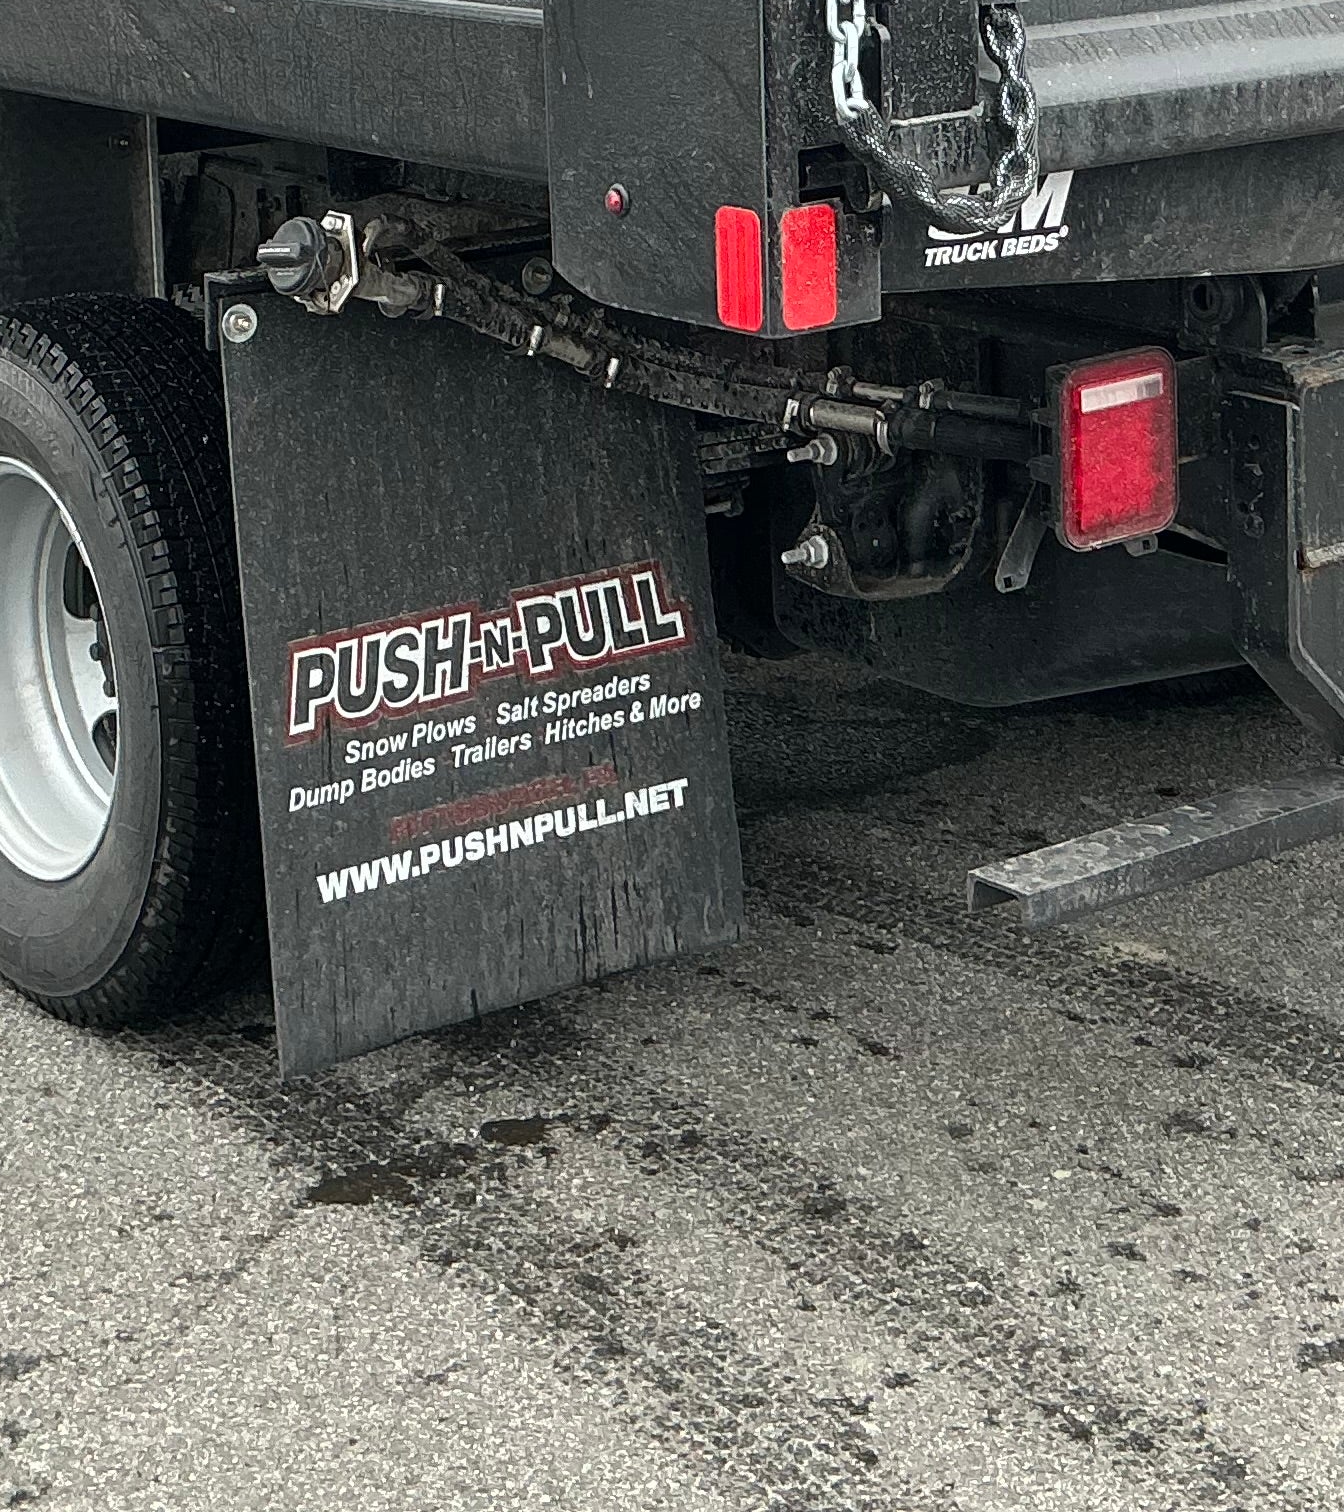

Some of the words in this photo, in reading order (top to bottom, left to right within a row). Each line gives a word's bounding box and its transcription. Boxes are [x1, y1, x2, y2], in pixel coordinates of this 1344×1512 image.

[924, 239, 999, 267] TRUCK
[288, 778, 355, 813] Dump
[360, 756, 436, 793] Bodies
[450, 731, 533, 769] Trailers
[544, 709, 625, 745] Hitches
[629, 700, 646, 723] &
[648, 691, 702, 720] More
[344, 732, 408, 764] Snow
[411, 714, 477, 748] Plows
[496, 695, 539, 725] Salt
[542, 673, 651, 717] Spreaders
[316, 777, 690, 904] WWW.PUSHNPULL.NET
